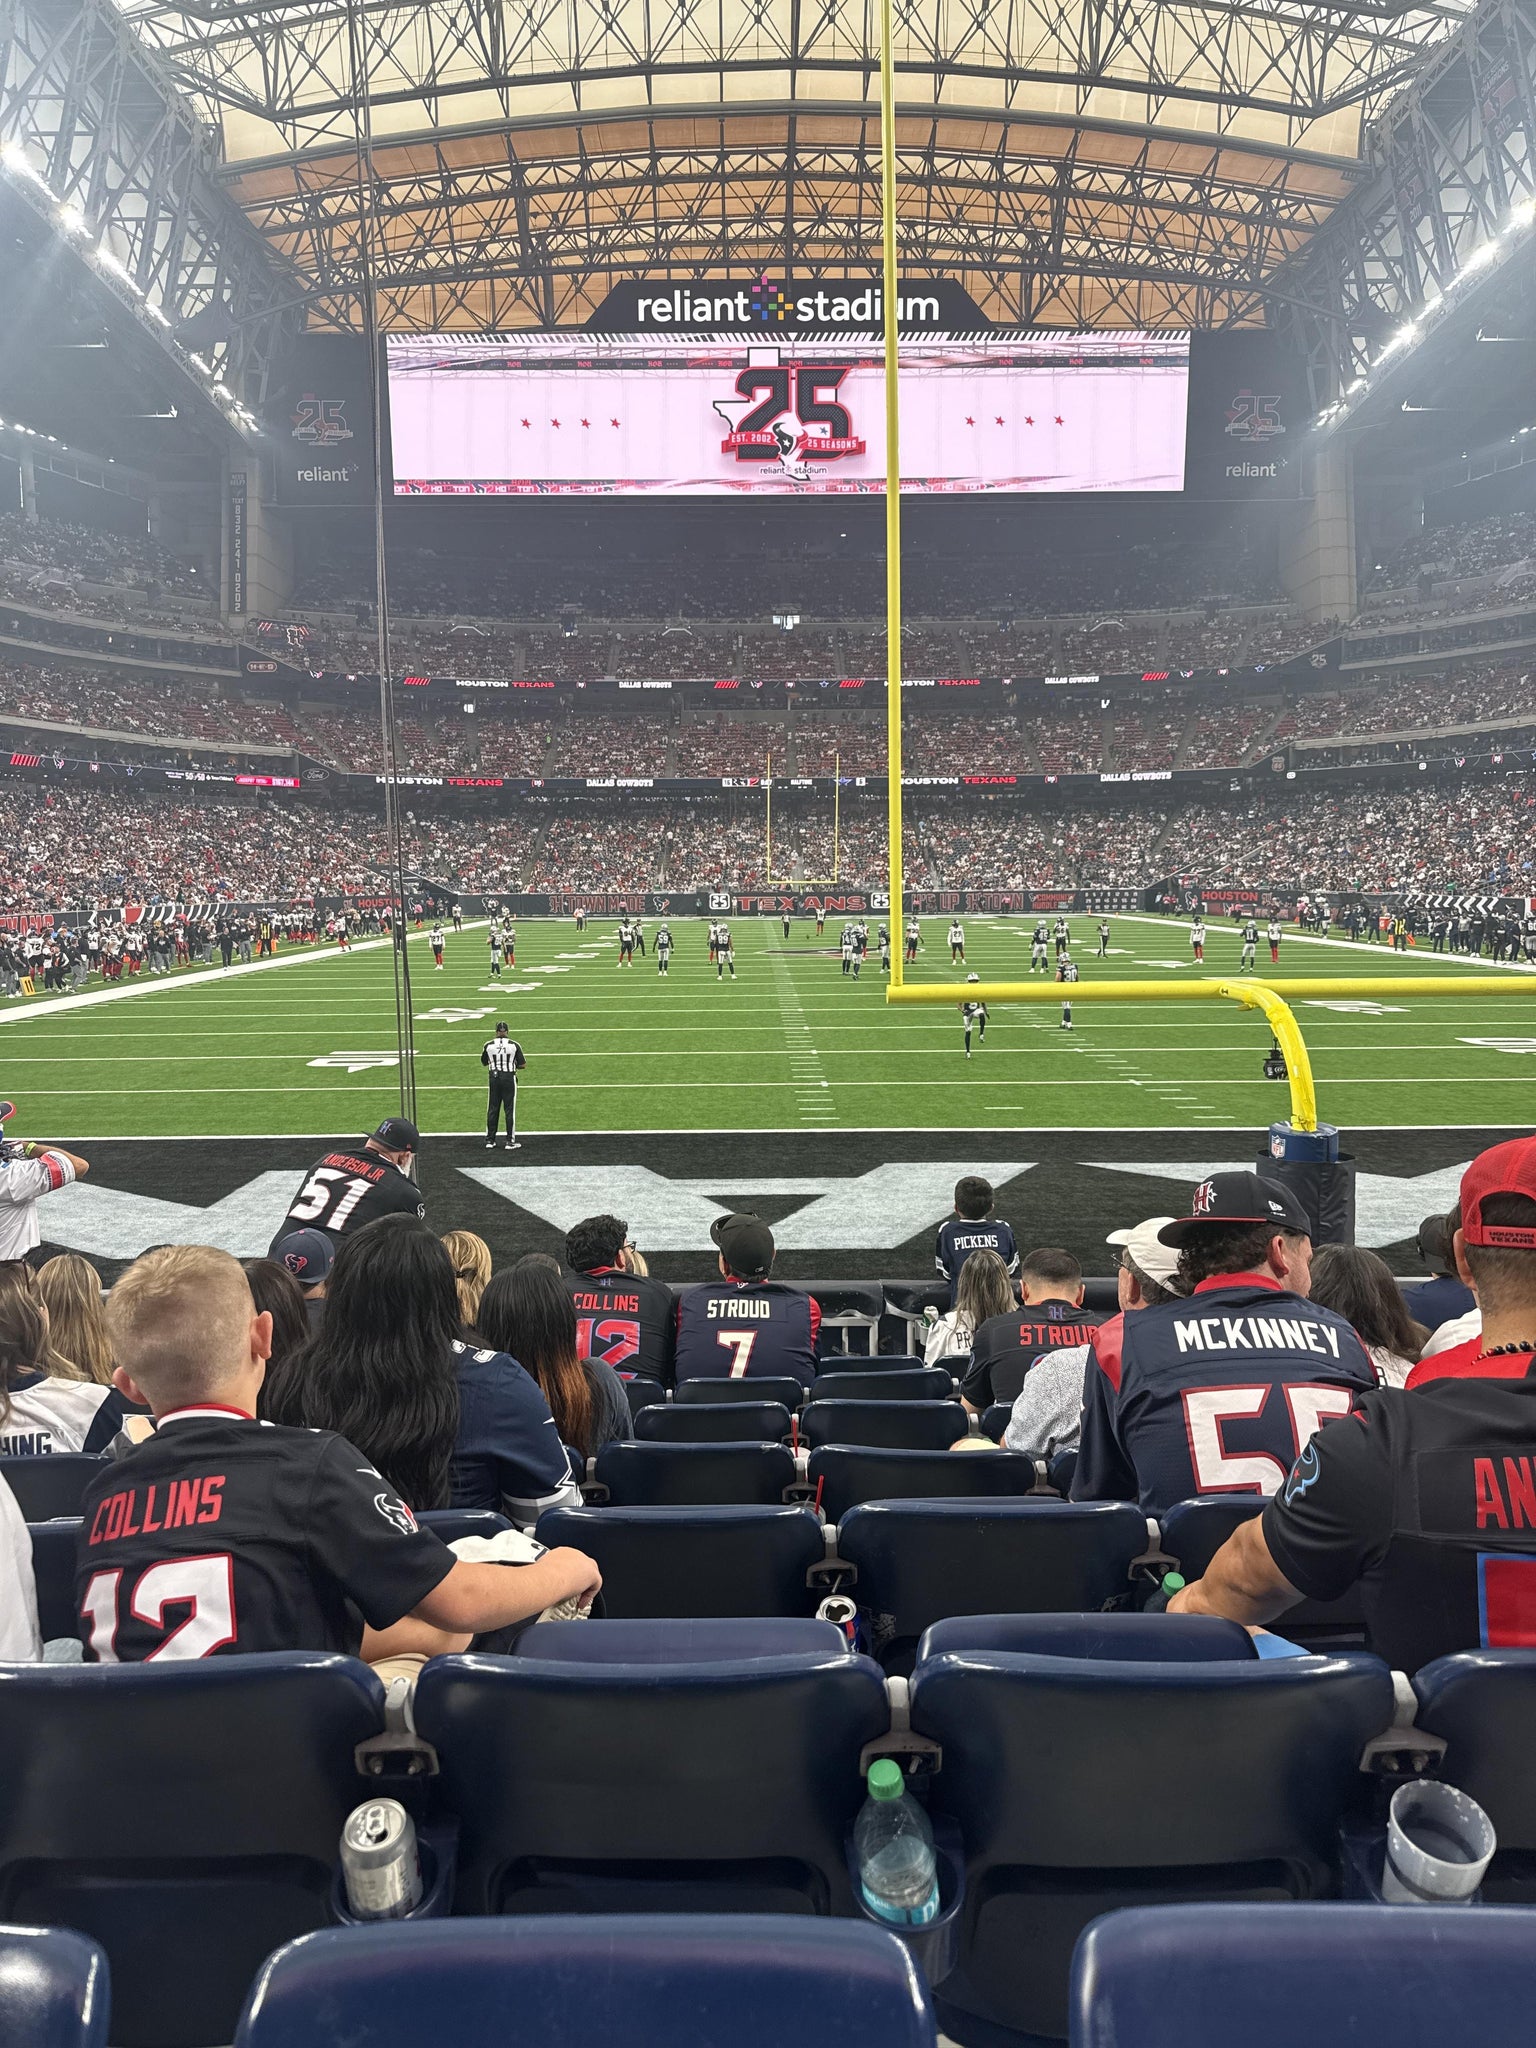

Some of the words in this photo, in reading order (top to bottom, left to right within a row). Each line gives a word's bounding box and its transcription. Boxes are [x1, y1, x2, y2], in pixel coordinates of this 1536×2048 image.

[637, 289, 751, 322] reliant
[796, 288, 940, 322] stadim
[297, 400, 346, 440] 25
[735, 366, 852, 462] 25
[1230, 395, 1281, 436] 25
[731, 434, 749, 444] EST.
[751, 433, 772, 443] 2002
[807, 439, 818, 448] 25
[820, 439, 857, 449] SEASONS
[297, 466, 349, 482] reliant
[760, 466, 785, 475] reliant
[794, 466, 828, 475] stadium
[1226, 462, 1277, 478] reliant
[456, 680, 508, 688] HOUSTON
[512, 681, 555, 689] TEXANS
[618, 681, 641, 689] DALLAS
[643, 681, 672, 689] COWBOYS
[884, 679, 934, 687] USTON
[1044, 676, 1067, 684] DALLAS
[1069, 675, 1099, 683] COWBOYS
[306, 769, 325, 780] Ford
[376, 776, 443, 785] HOUSTON
[447, 778, 503, 787] TEXANS
[963, 776, 1017, 784] TEXANS
[1100, 773, 1130, 783] DALLAS
[1131, 771, 1172, 781] COWBOYS
[586, 778, 614, 788] DALLAS
[616, 778, 654, 788] COWBOYS
[712, 895, 728, 908] 25
[872, 895, 889, 908] 25
[940, 893, 960, 911] UP
[1201, 891, 1258, 900] HOUSTON
[737, 896, 866, 911] TEXANS
[658, 935, 669, 944] 59
[1063, 969, 1078, 982] 30
[24, 980, 34, 995] 11
[321, 1153, 372, 1178] ANDERSON
[368, 1168, 386, 1182] JR
[287, 1167, 376, 1231] 51
[953, 1234, 999, 1250] PICKENS
[1490, 1236, 1535, 1244] TEXANS
[573, 1293, 639, 1313] COLLINS
[707, 1299, 770, 1318] STROUD
[956, 1331, 972, 1349] PR
[1173, 1317, 1340, 1358] MCKINNEY
[576, 1318, 640, 1379] 12
[717, 1329, 758, 1379] 7
[1474, 1457, 1536, 1529] AN
[89, 1475, 226, 1546] COLLINS
[81, 1552, 238, 1663] 12
